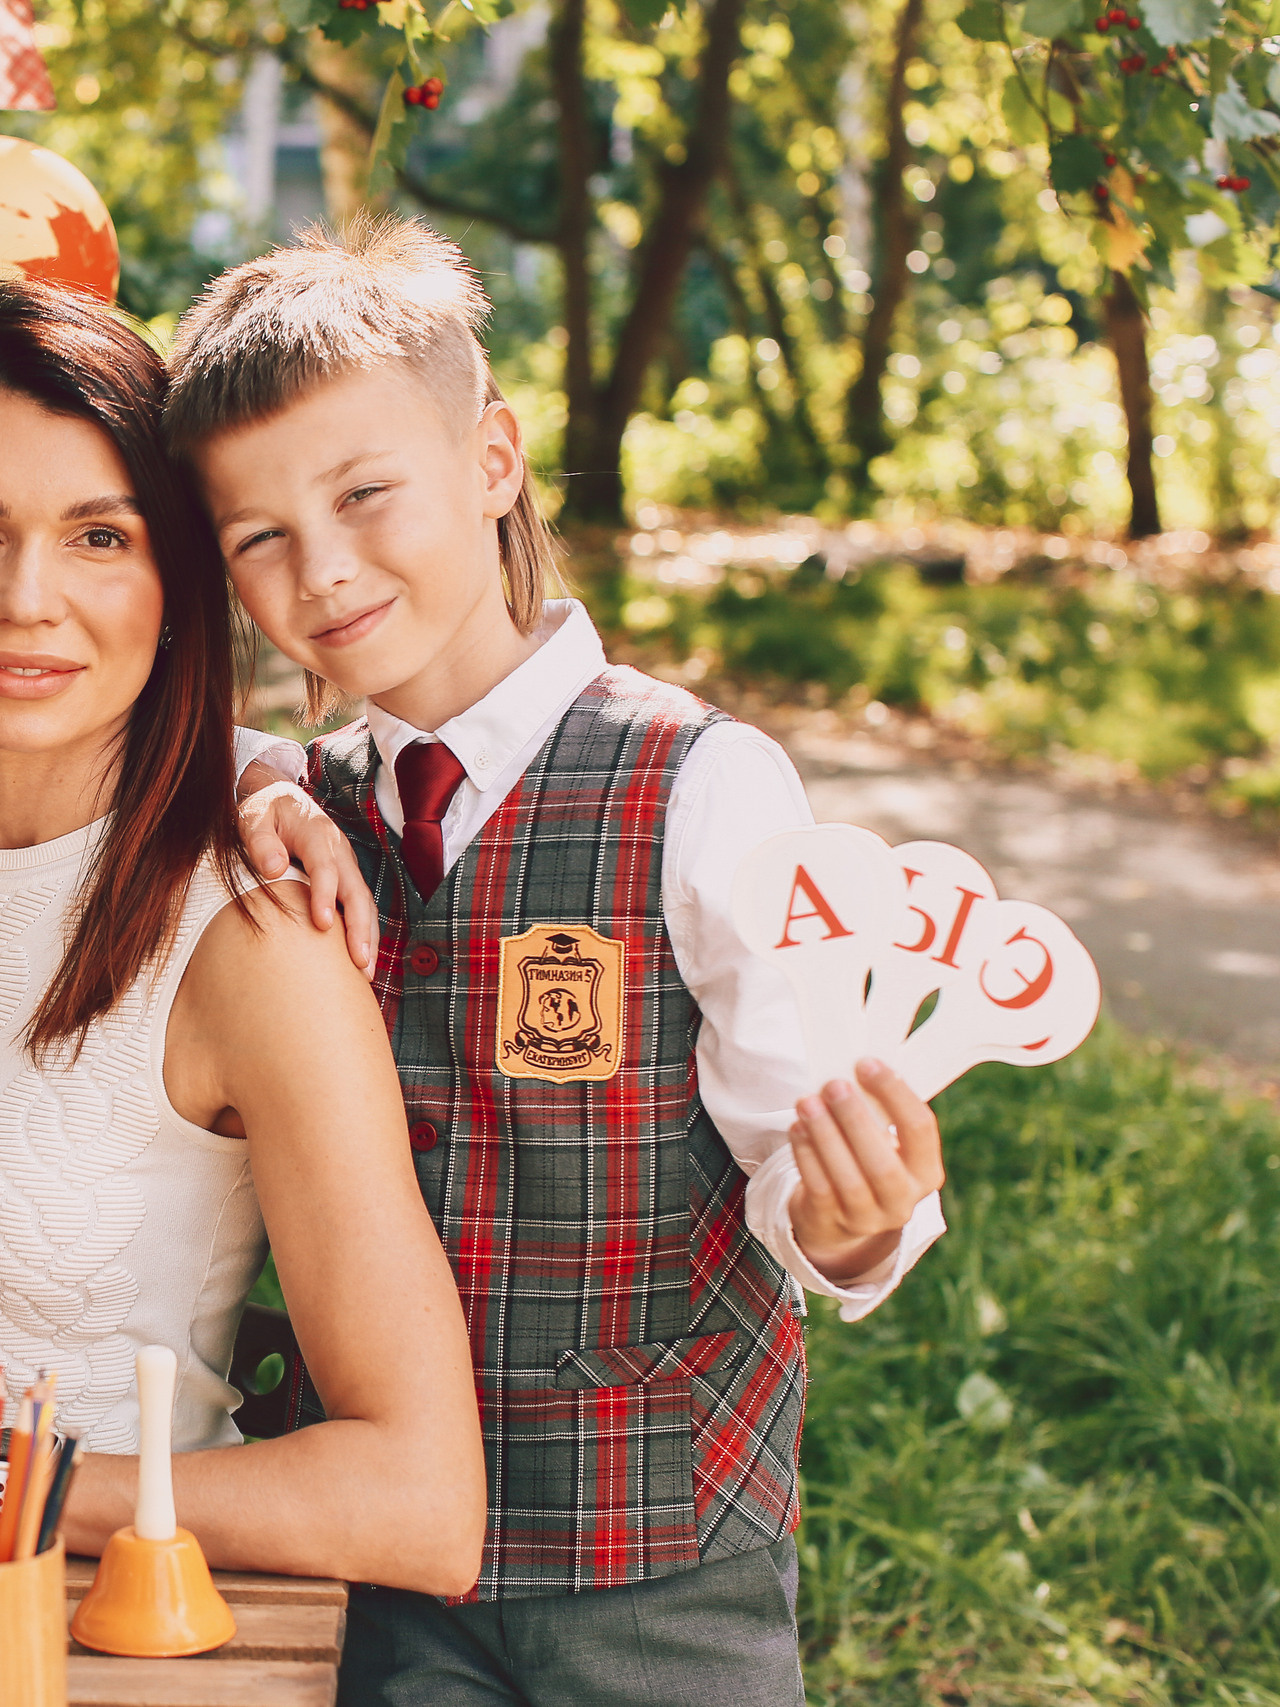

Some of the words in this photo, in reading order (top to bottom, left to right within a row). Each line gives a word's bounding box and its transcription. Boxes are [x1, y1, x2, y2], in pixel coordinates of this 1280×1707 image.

[772, 863, 854, 950] А
[528, 968, 583, 982] ГИМНАЗИЯ
[584, 968, 593, 983] 5
[979, 925, 1054, 1010] Э
